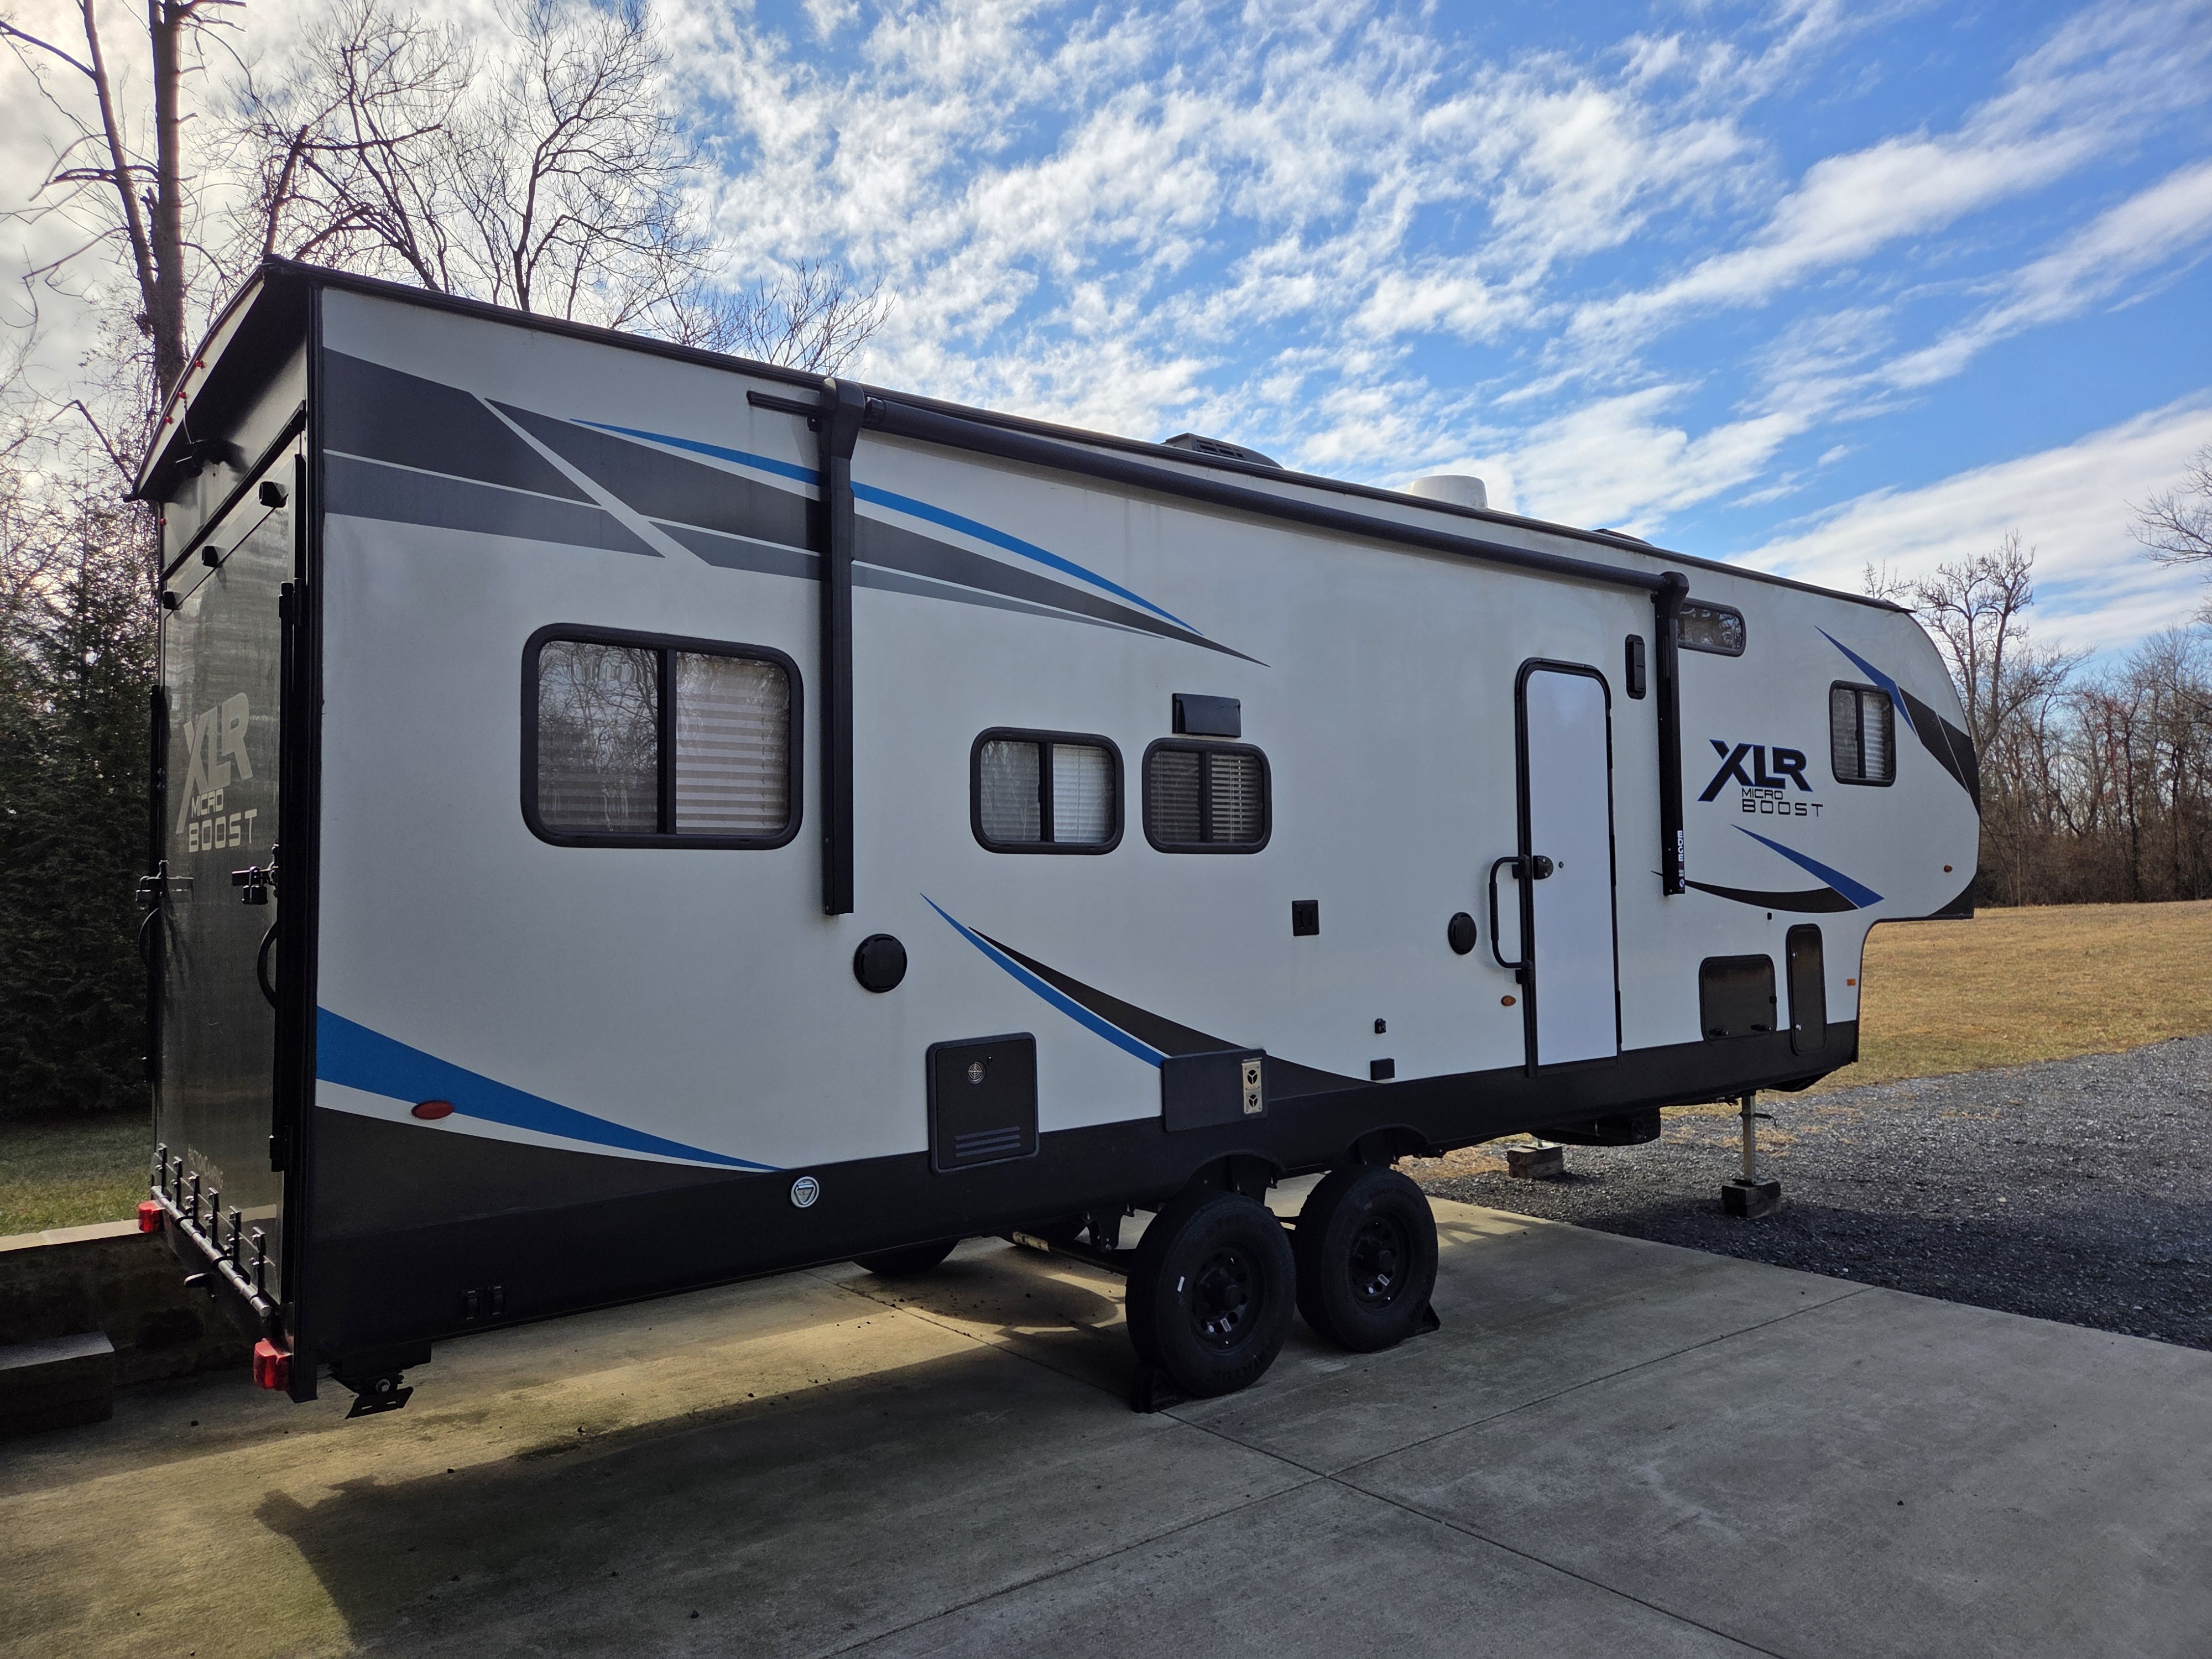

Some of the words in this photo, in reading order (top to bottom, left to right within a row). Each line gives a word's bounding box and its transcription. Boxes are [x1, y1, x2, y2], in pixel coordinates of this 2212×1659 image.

[176, 692, 253, 834] XLR
[1697, 739, 1813, 802] XLR
[1742, 787, 1783, 800] MICRO
[1743, 799, 1823, 817] BOOST
[189, 808, 257, 853] BOOST
